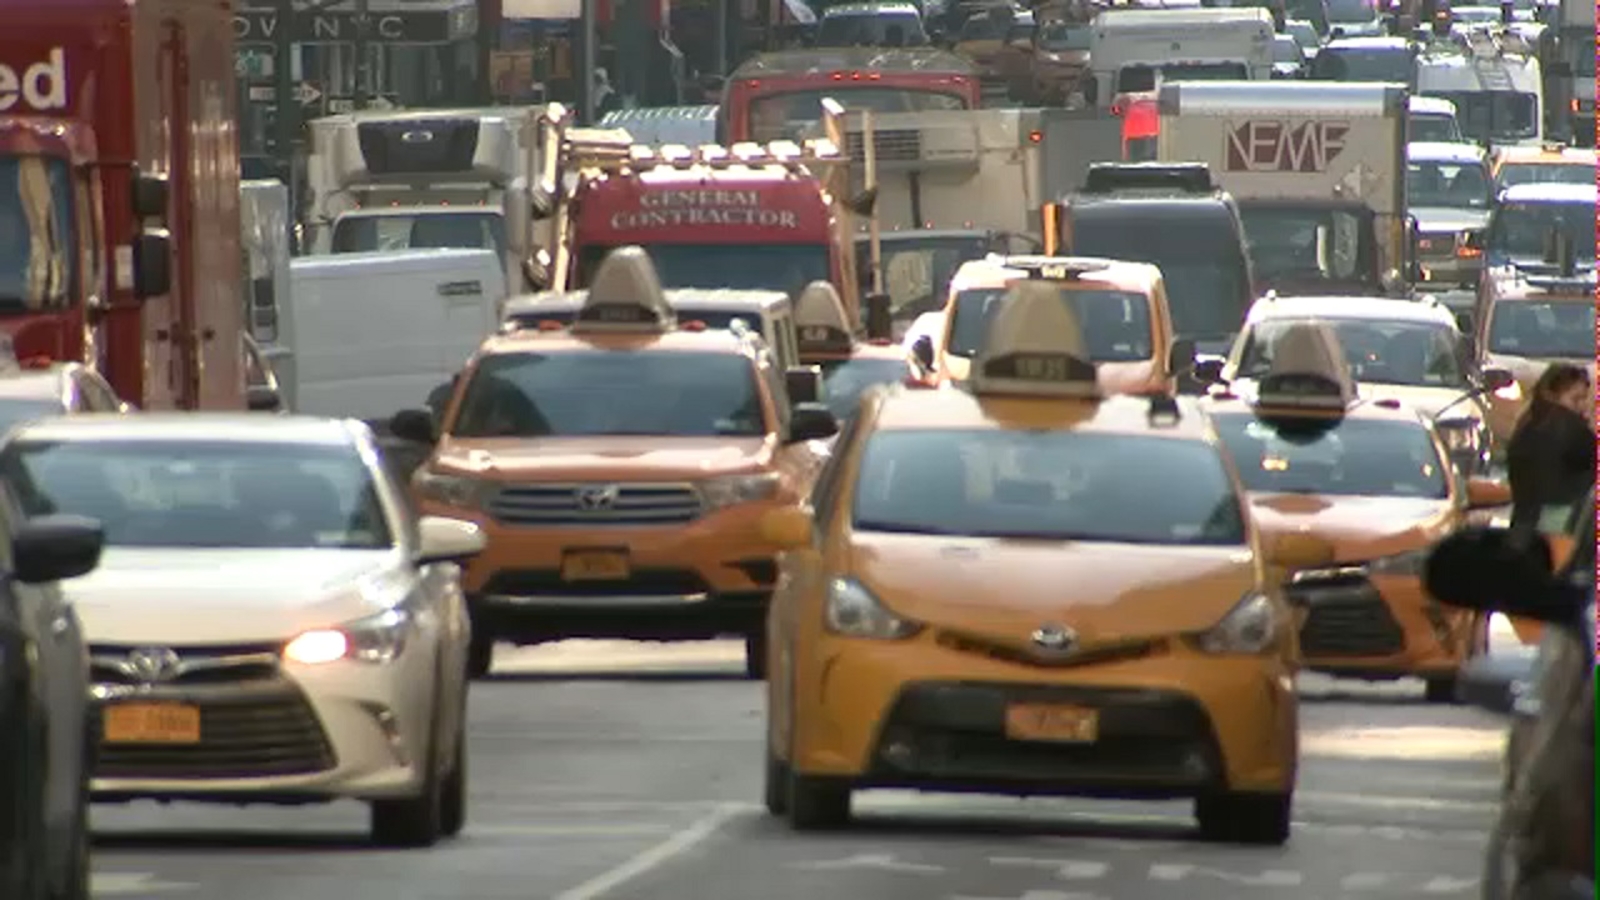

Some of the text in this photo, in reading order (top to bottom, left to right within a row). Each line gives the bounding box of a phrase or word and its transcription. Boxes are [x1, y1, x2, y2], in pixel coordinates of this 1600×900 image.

[1223, 120, 1350, 171] NEMF
[639, 189, 760, 207] GENERAL
[610, 207, 798, 230] CONTRACTOR
